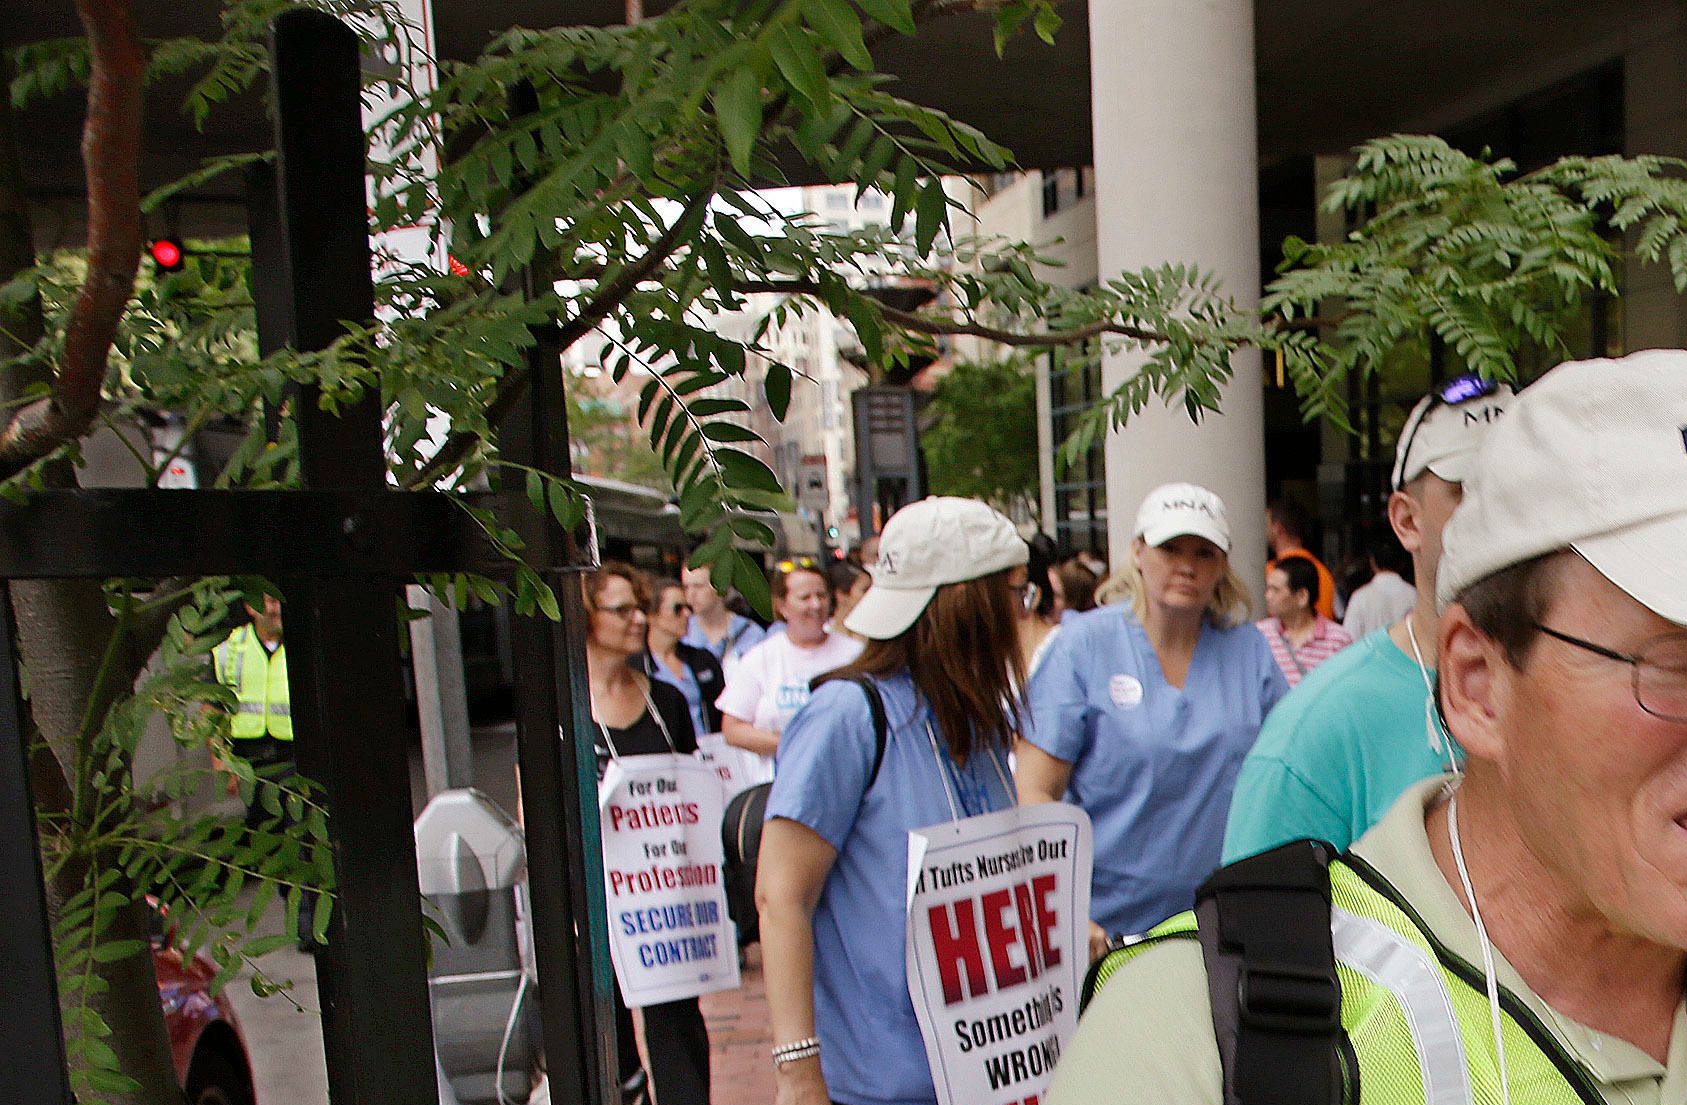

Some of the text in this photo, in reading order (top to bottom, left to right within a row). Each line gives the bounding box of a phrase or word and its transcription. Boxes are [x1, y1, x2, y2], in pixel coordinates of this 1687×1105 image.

[930, 860, 975, 890] Tufts
[1038, 838, 1068, 862] Out
[928, 873, 1061, 1006] HERE
